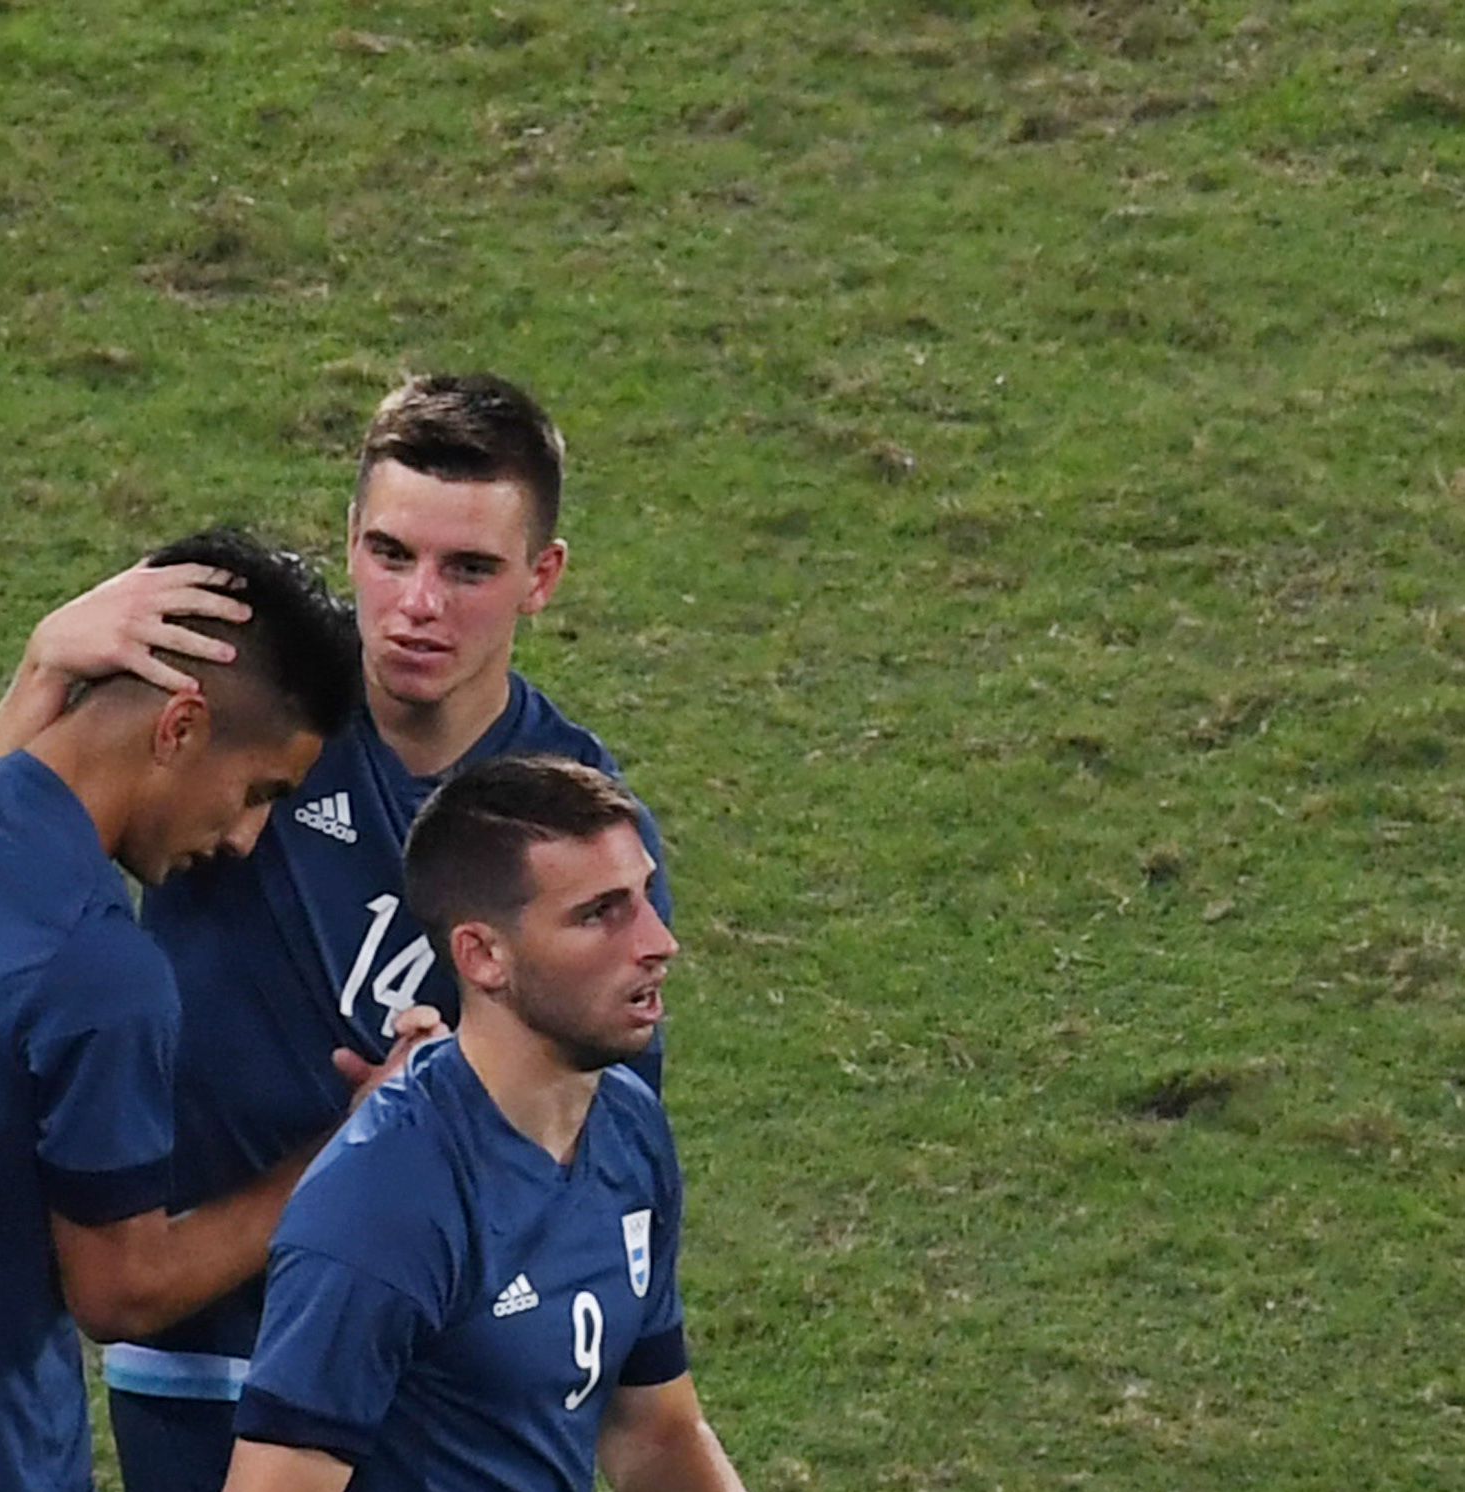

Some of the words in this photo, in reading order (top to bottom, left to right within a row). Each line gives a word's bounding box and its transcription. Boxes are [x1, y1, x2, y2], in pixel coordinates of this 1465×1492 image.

[294, 807, 358, 844] adidas
[339, 893, 437, 1038] 14
[564, 1290, 603, 1411] 9
